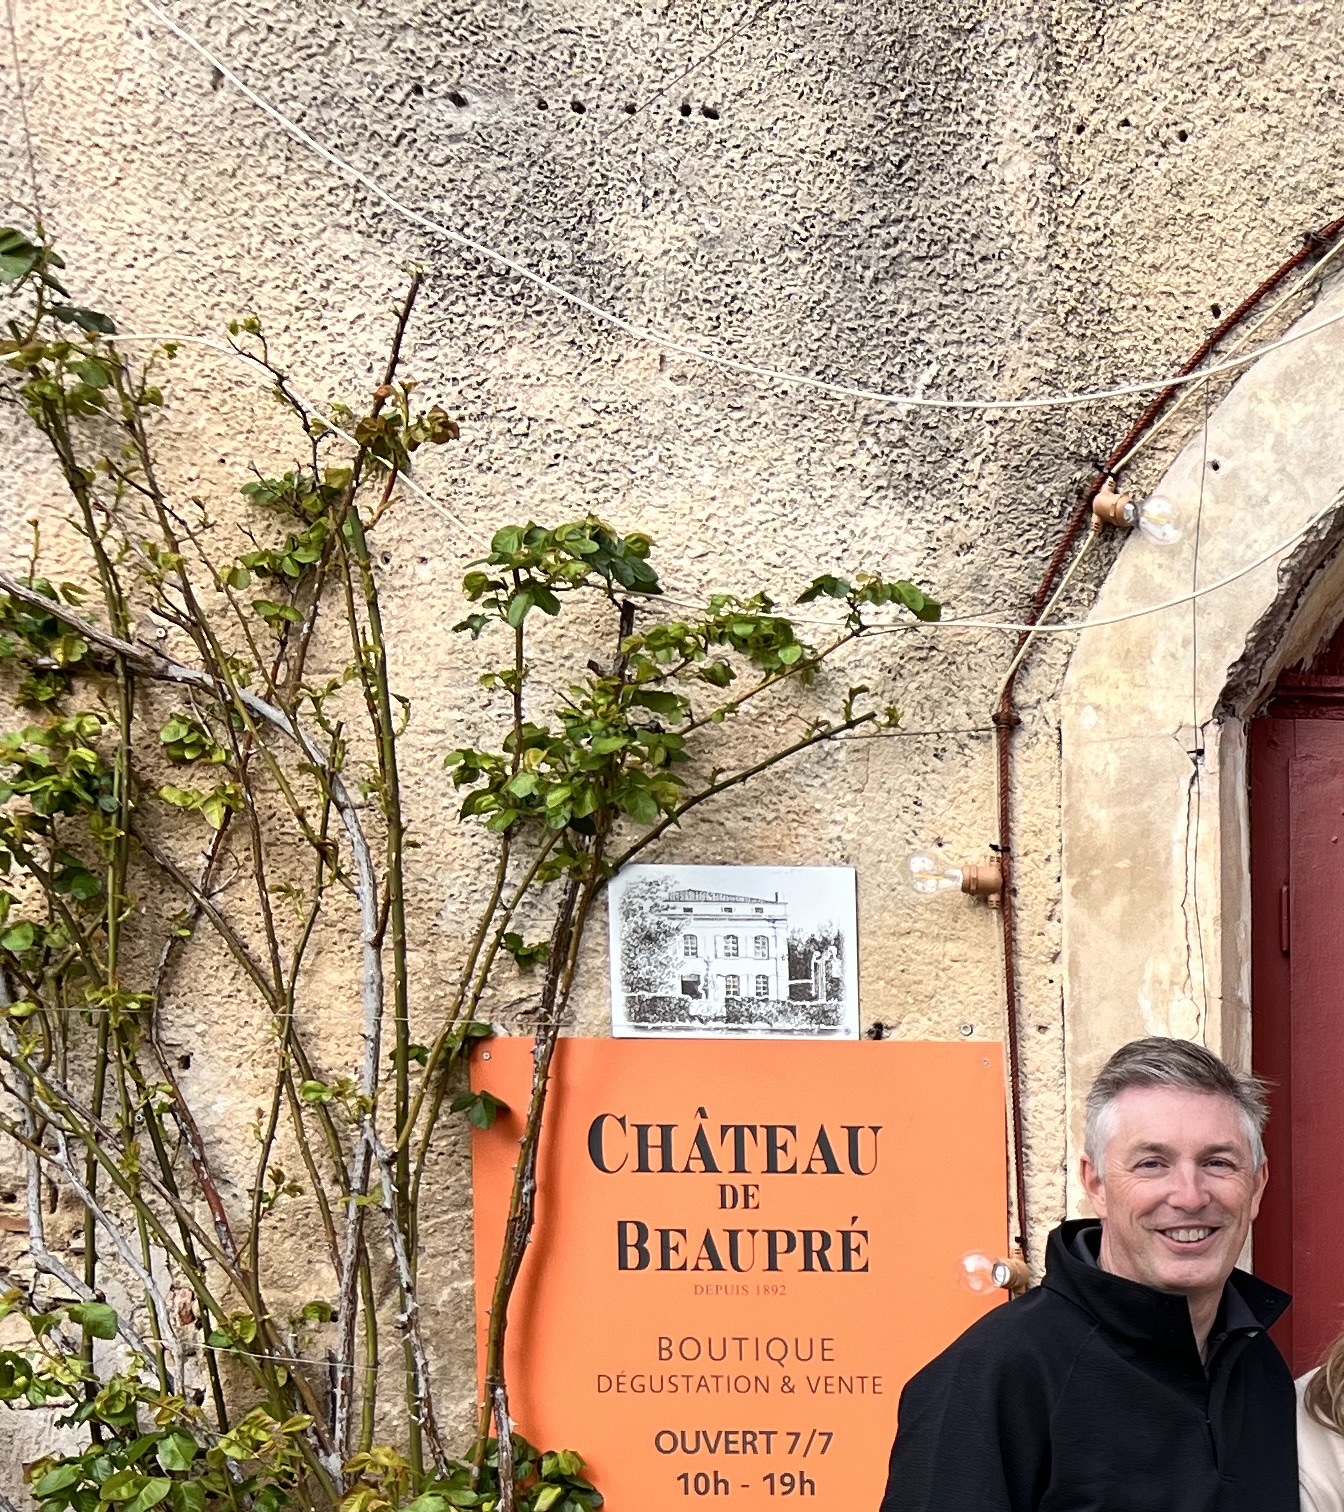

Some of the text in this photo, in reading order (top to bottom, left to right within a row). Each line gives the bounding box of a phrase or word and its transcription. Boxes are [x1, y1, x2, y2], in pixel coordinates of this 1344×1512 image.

[587, 1106, 884, 1177] CHÂTEAU
[717, 1183, 760, 1210] DE
[616, 1215, 869, 1273] BEAUPRÉ
[693, 1284, 787, 1297] DEPUIS 1892
[657, 1336, 836, 1368] BOUTIQUE
[596, 1370, 884, 1395] DÉGUSTATION & VENTE
[654, 1429, 834, 1457] OUVERT 7/7
[676, 1471, 730, 1496] 10h
[762, 1471, 816, 1497] 19h
